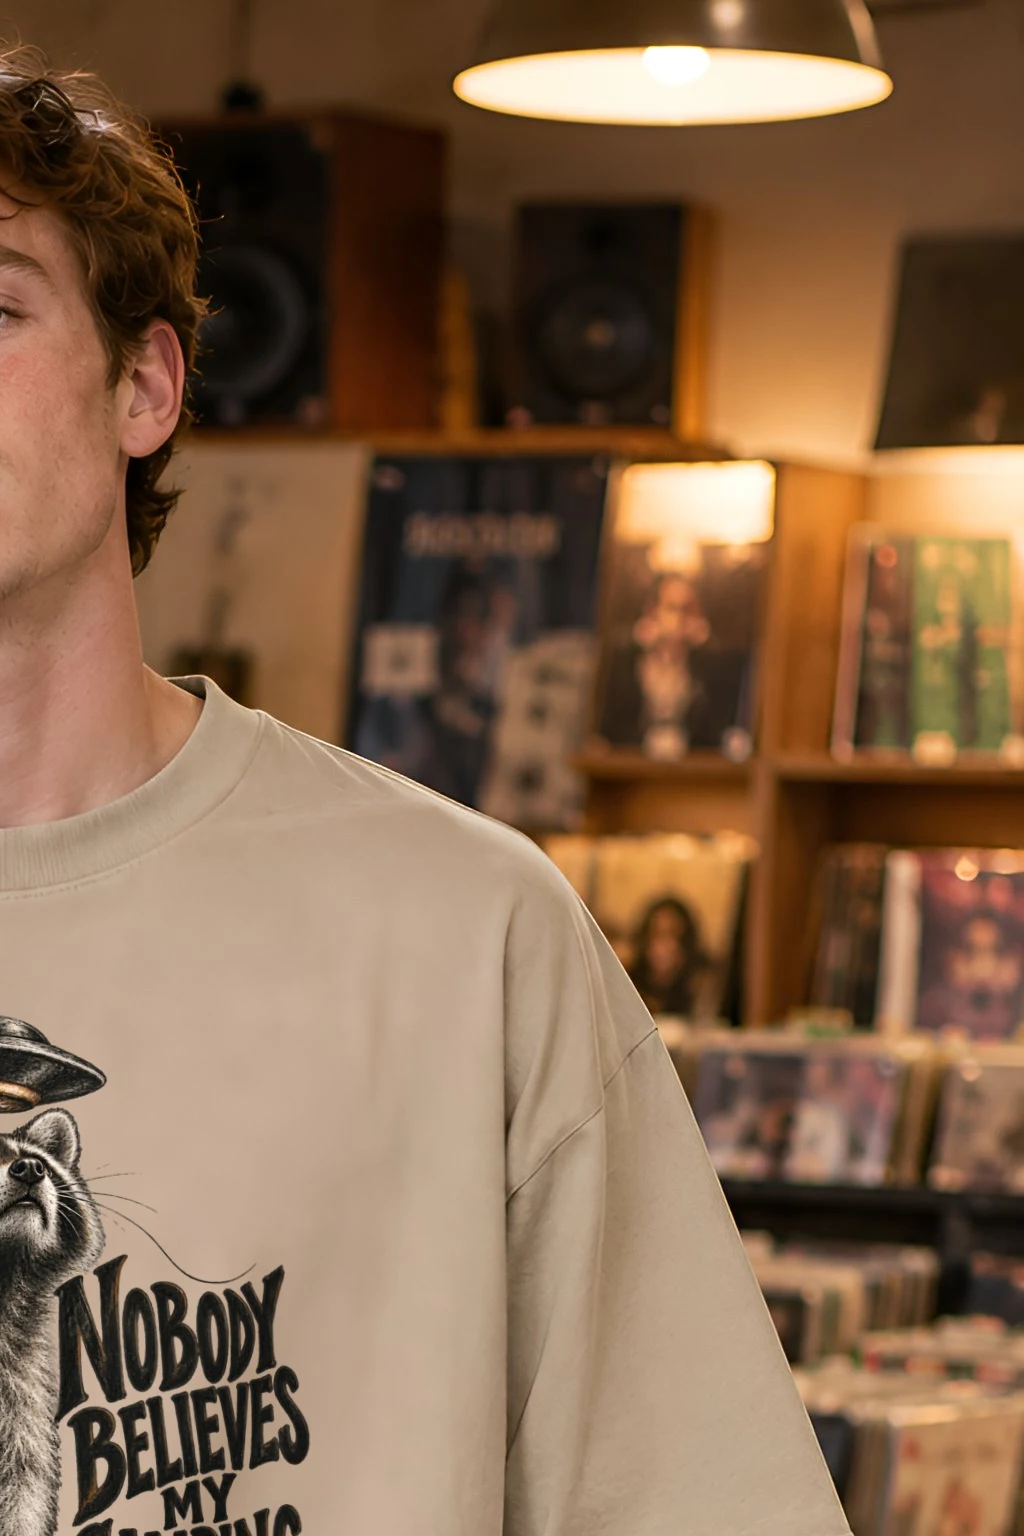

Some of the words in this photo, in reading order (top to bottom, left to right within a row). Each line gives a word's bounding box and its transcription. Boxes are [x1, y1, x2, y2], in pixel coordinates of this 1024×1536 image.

[55, 1254, 285, 1420] NOBODY
[67, 1366, 310, 1526] BELIEVES
[161, 1473, 236, 1530] MY
